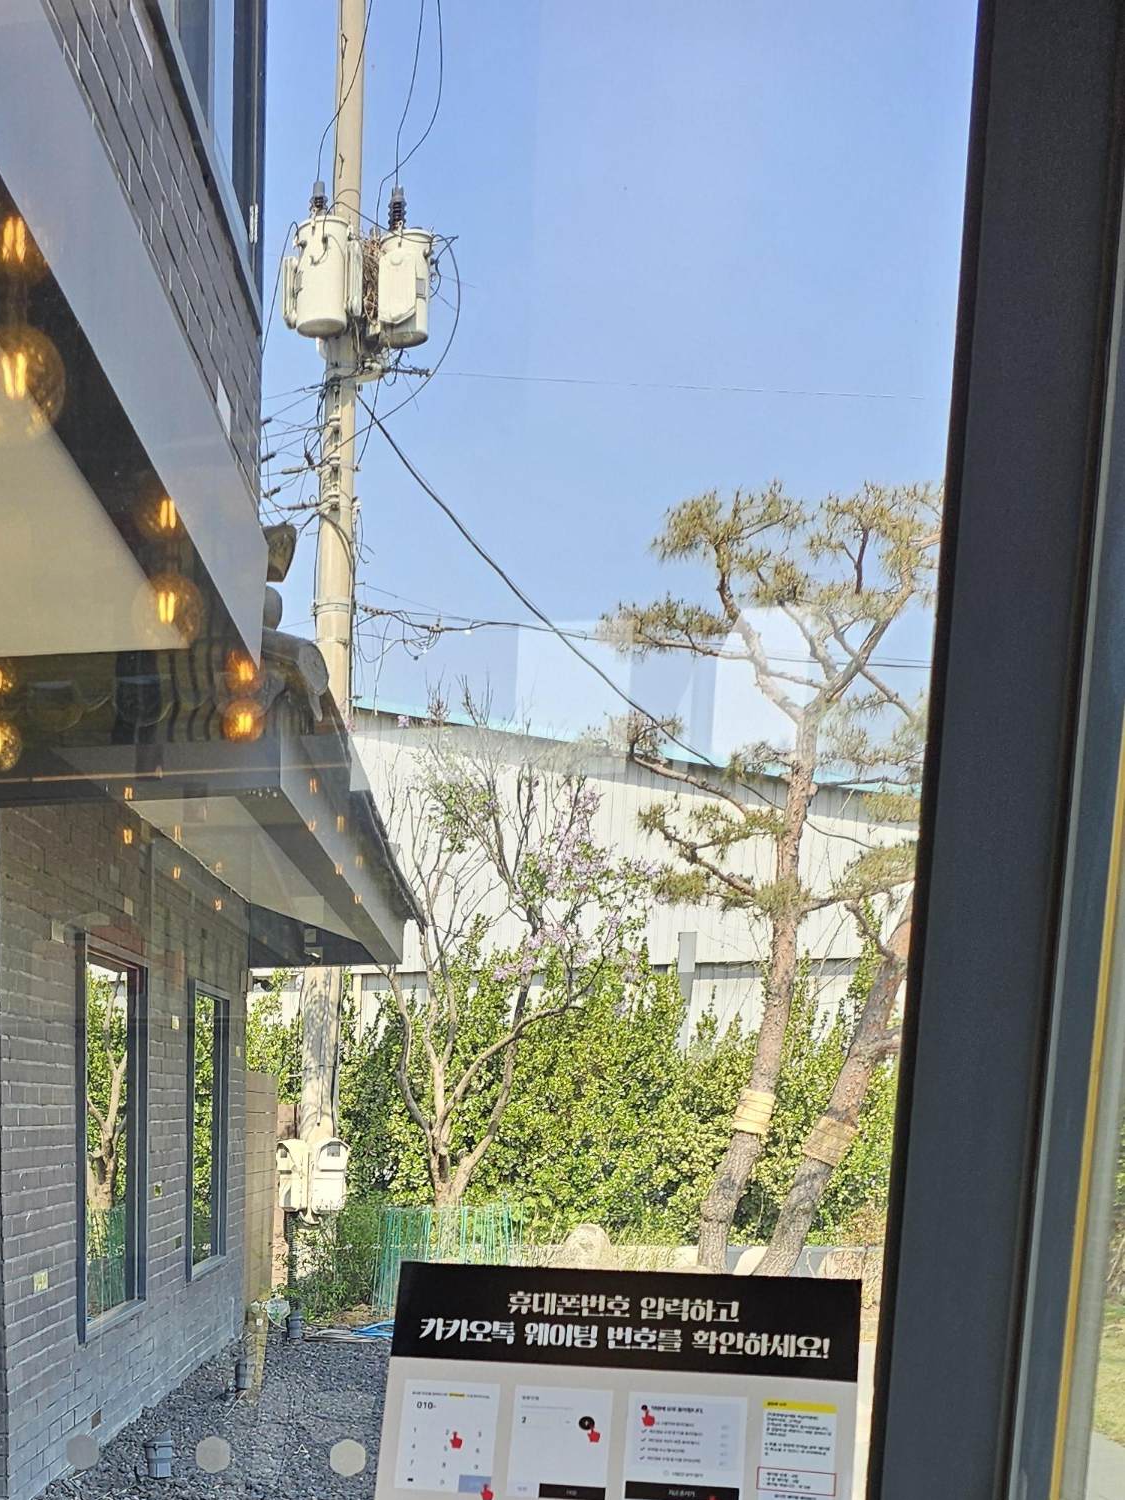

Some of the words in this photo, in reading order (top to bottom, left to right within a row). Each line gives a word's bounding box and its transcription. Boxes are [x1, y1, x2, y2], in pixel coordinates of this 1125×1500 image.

[507, 1290, 632, 1319] 휴대폰번호
[640, 1297, 741, 1324] 입력하고
[419, 1317, 516, 1344] 카카오톡
[523, 1321, 600, 1350] 웨이팅
[607, 1325, 683, 1353] 번호를
[691, 1328, 832, 1361] 확인하세요!
